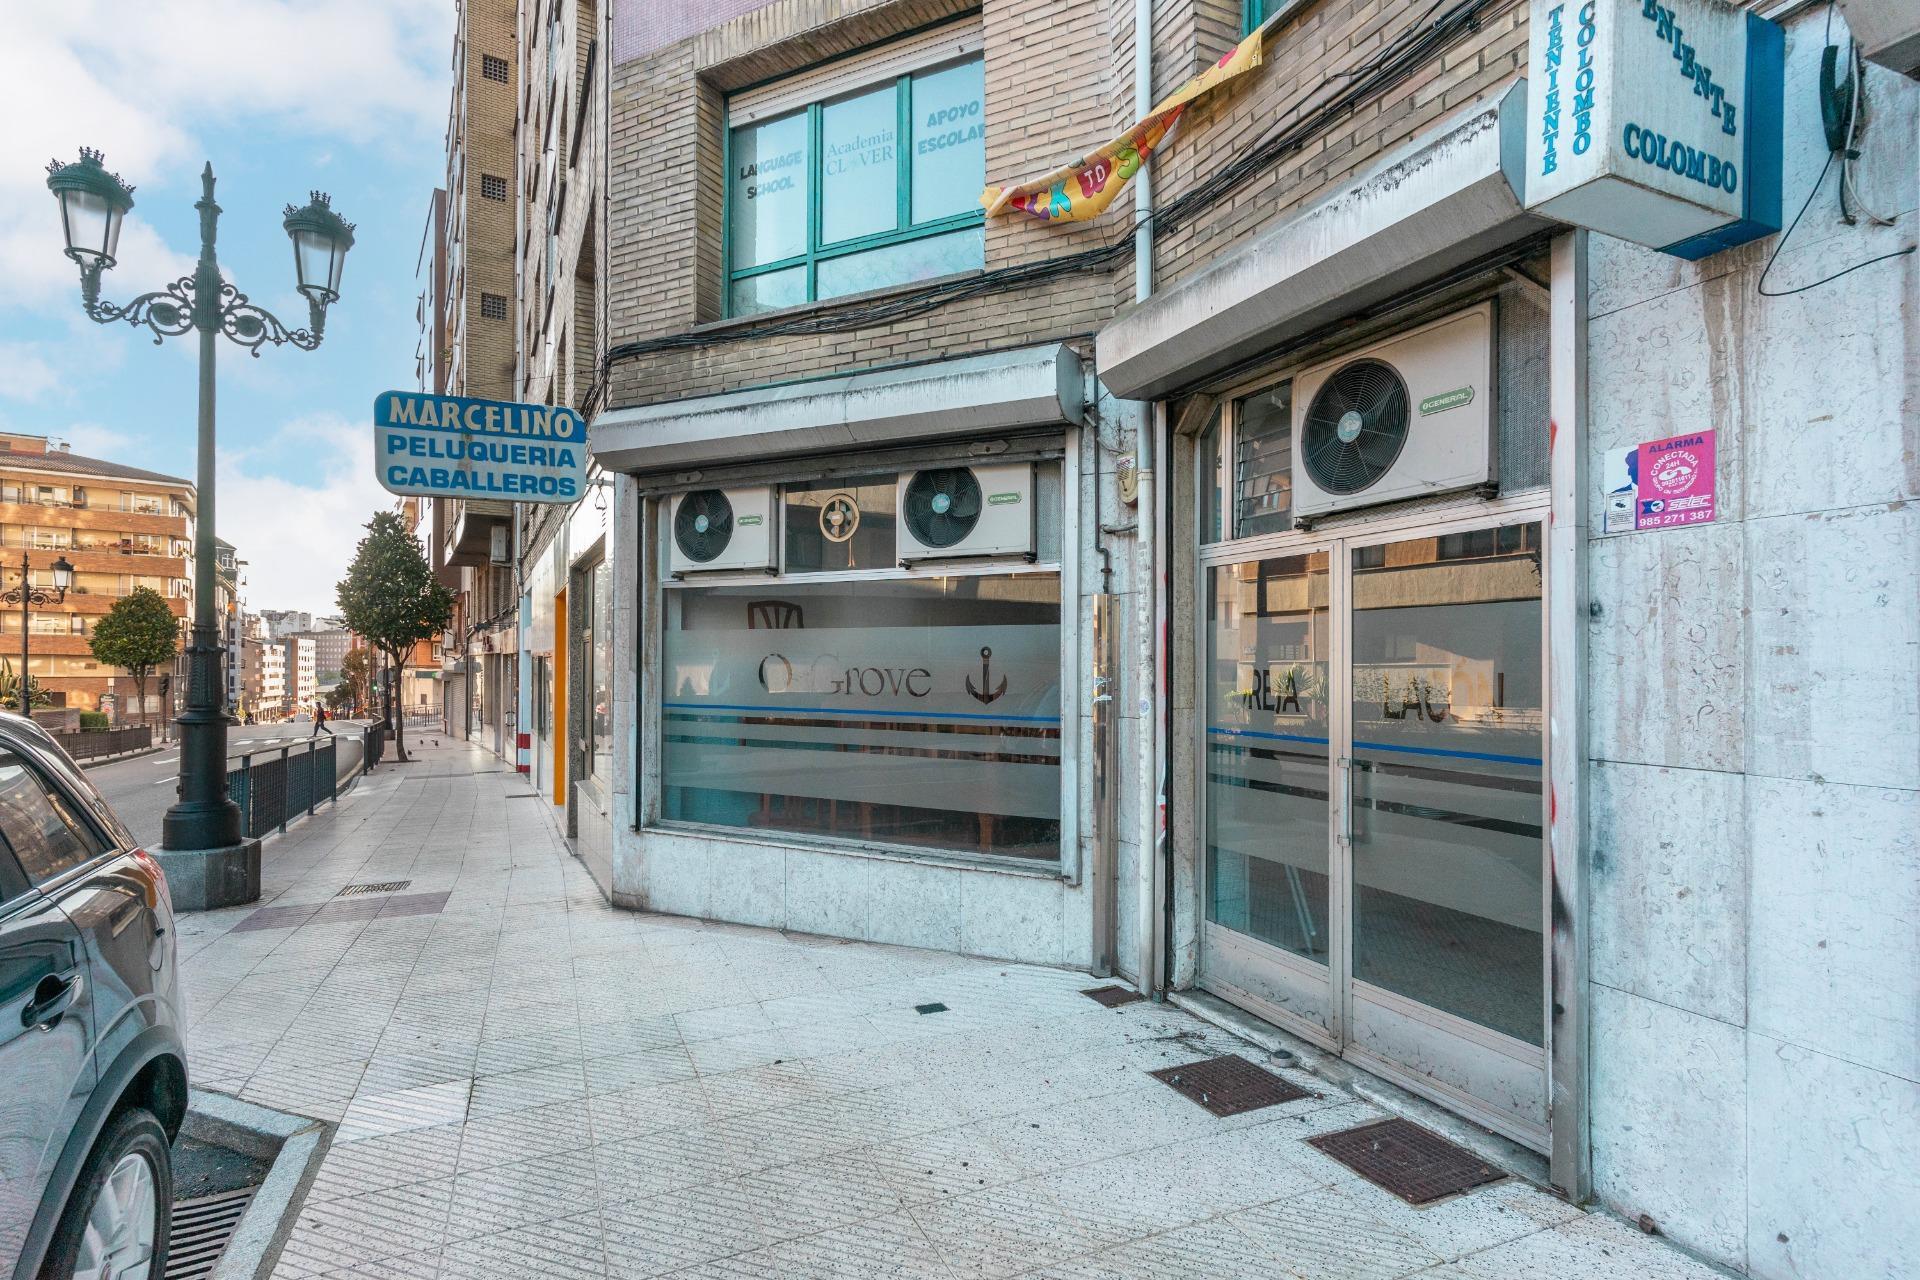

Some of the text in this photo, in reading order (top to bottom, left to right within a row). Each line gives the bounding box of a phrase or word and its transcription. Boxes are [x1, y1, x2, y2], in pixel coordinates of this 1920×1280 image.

[1573, 0, 1596, 155] COLOMBO
[1638, 0, 1737, 136] ENIENTE
[1541, 4, 1565, 176] TENIENTE
[927, 100, 980, 128] APOYO
[827, 127, 894, 159] Academia
[1623, 122, 1738, 194] COLOMBO
[739, 150, 803, 181] LANGUAGE
[747, 175, 795, 200] SCHOOL
[388, 396, 574, 438] MARCELINO
[387, 434, 577, 468] PELUQUERIA
[1648, 436, 1704, 454] ALARMA
[1650, 450, 1699, 476] CONECTADA
[388, 465, 576, 497] CABALLEROS
[1639, 516, 1661, 527] 985
[1664, 513, 1685, 524] 271
[1689, 509, 1713, 521] 387
[810, 653, 932, 698] Grove
